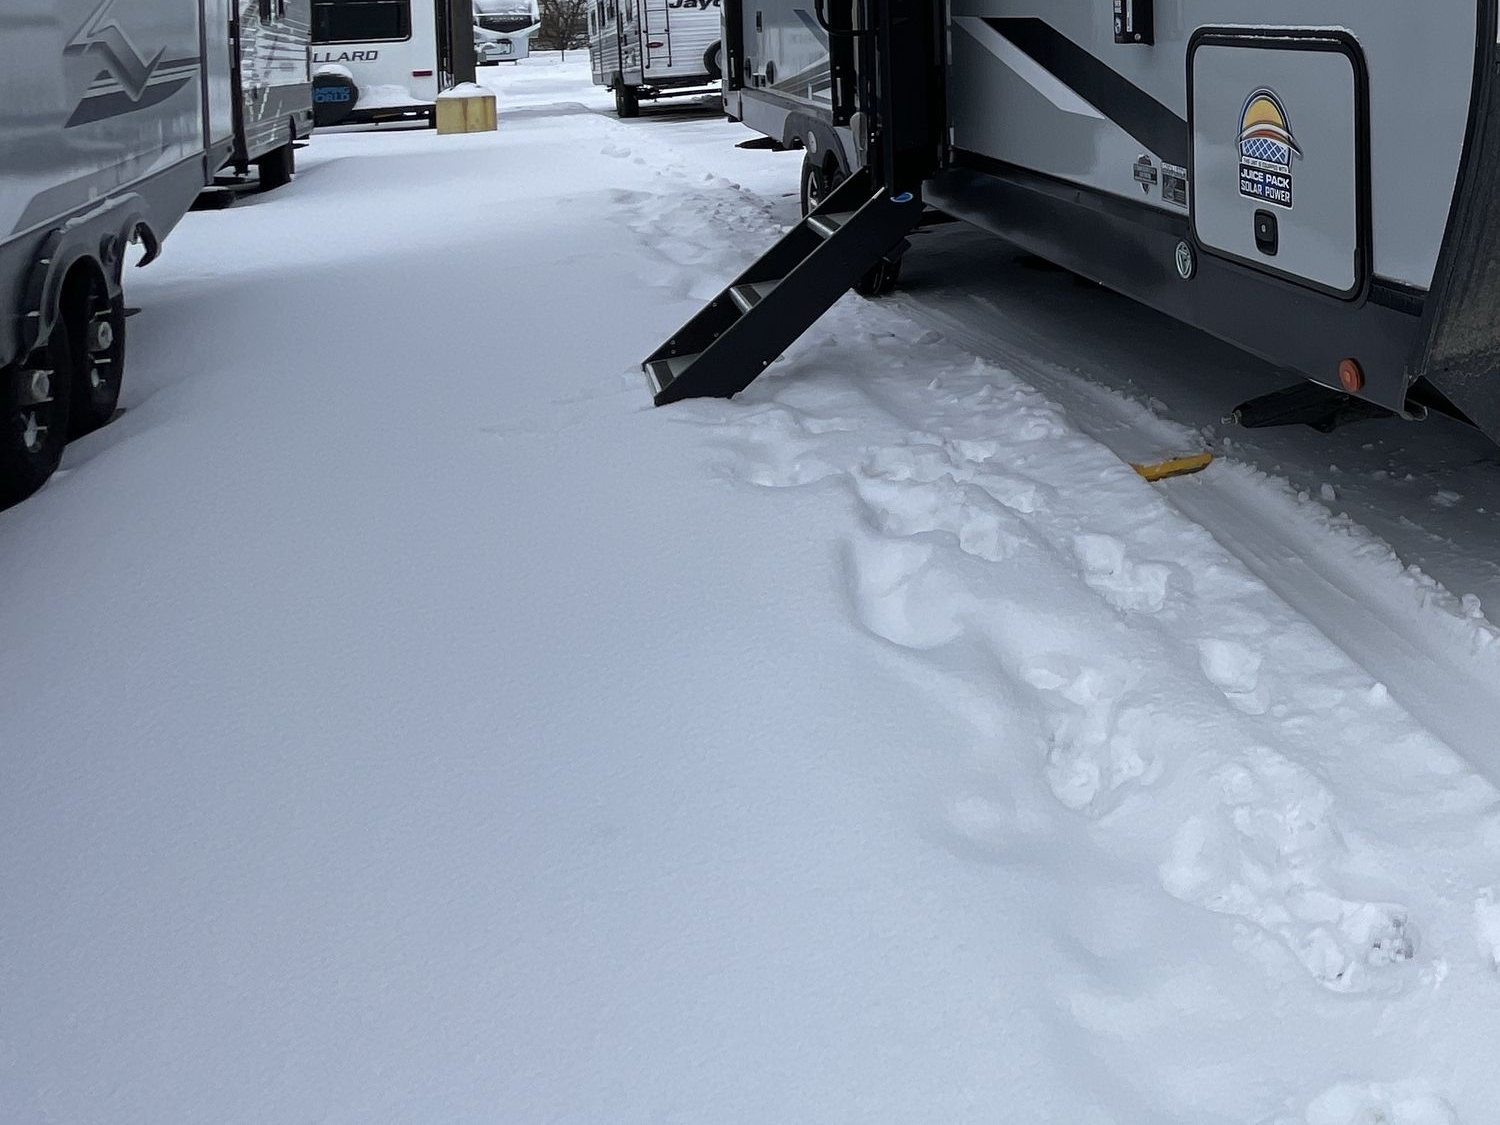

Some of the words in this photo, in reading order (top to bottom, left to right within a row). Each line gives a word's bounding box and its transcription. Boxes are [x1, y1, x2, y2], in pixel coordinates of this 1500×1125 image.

[1241, 169, 1264, 182] JUICE
[1266, 174, 1290, 189] PACK
[1241, 179, 1263, 195] SOLAR
[1265, 186, 1290, 203] POWER
